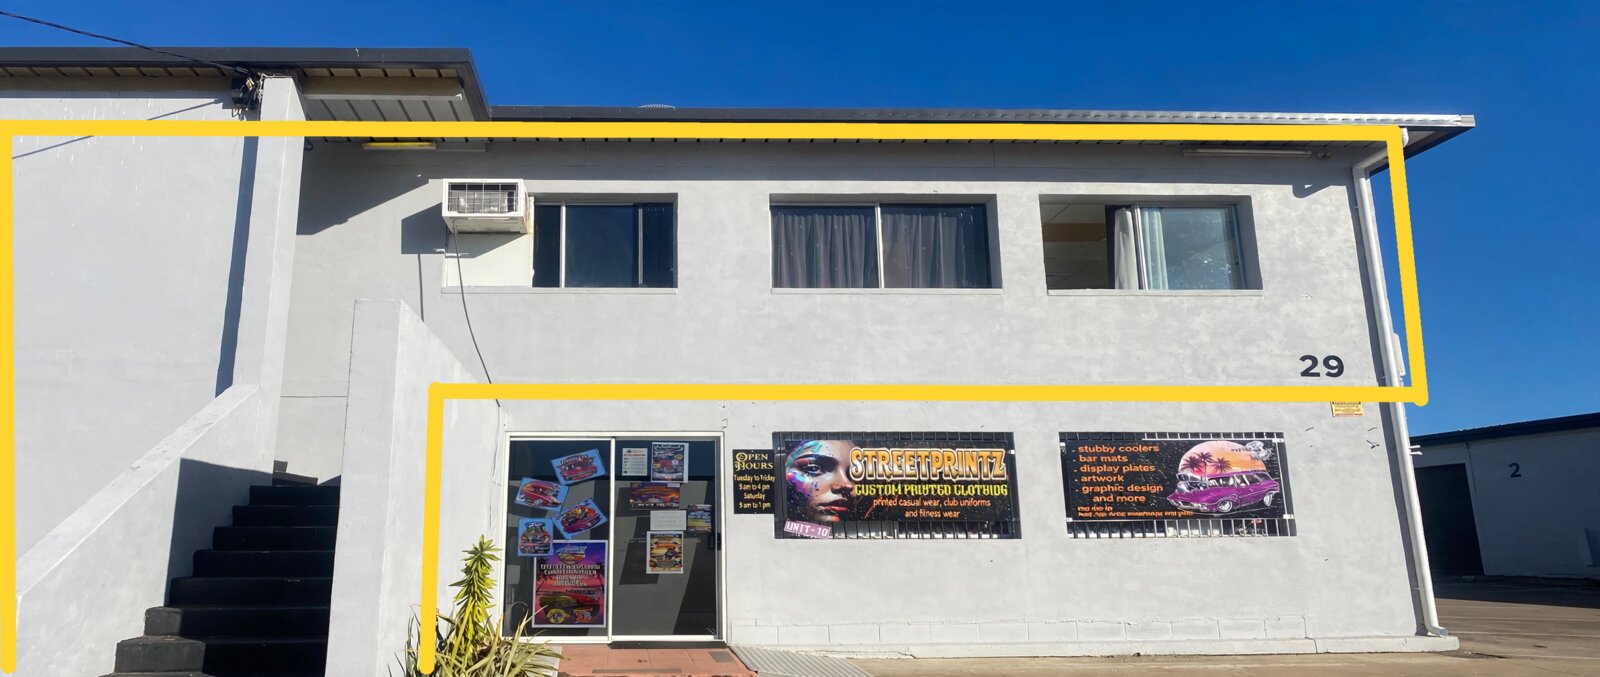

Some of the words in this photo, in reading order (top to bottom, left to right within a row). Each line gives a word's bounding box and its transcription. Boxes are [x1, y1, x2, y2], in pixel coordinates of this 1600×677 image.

[1299, 354, 1345, 378] 29
[1078, 445, 1116, 453] stubby
[735, 452, 769, 462] OPEN
[850, 447, 1008, 482] STREETPRINTZ
[1080, 464, 1120, 474] display
[1122, 464, 1156, 473] plates
[1509, 463, 1522, 478] 2
[1081, 474, 1124, 482] artwork
[854, 484, 901, 496] CUSTOM
[903, 484, 951, 496] PRINTED
[954, 484, 1008, 496] CLOTHING
[1081, 484, 1125, 494] graphic
[1127, 484, 1164, 493] design
[873, 497, 898, 507] printed
[898, 498, 922, 506] casual
[923, 499, 942, 508] wear,
[943, 497, 959, 506] club
[959, 498, 991, 506] uniforms
[1092, 494, 1114, 503] and
[904, 510, 918, 518] and
[919, 509, 941, 518] fitness
[786, 520, 829, 537] UNIT-10
